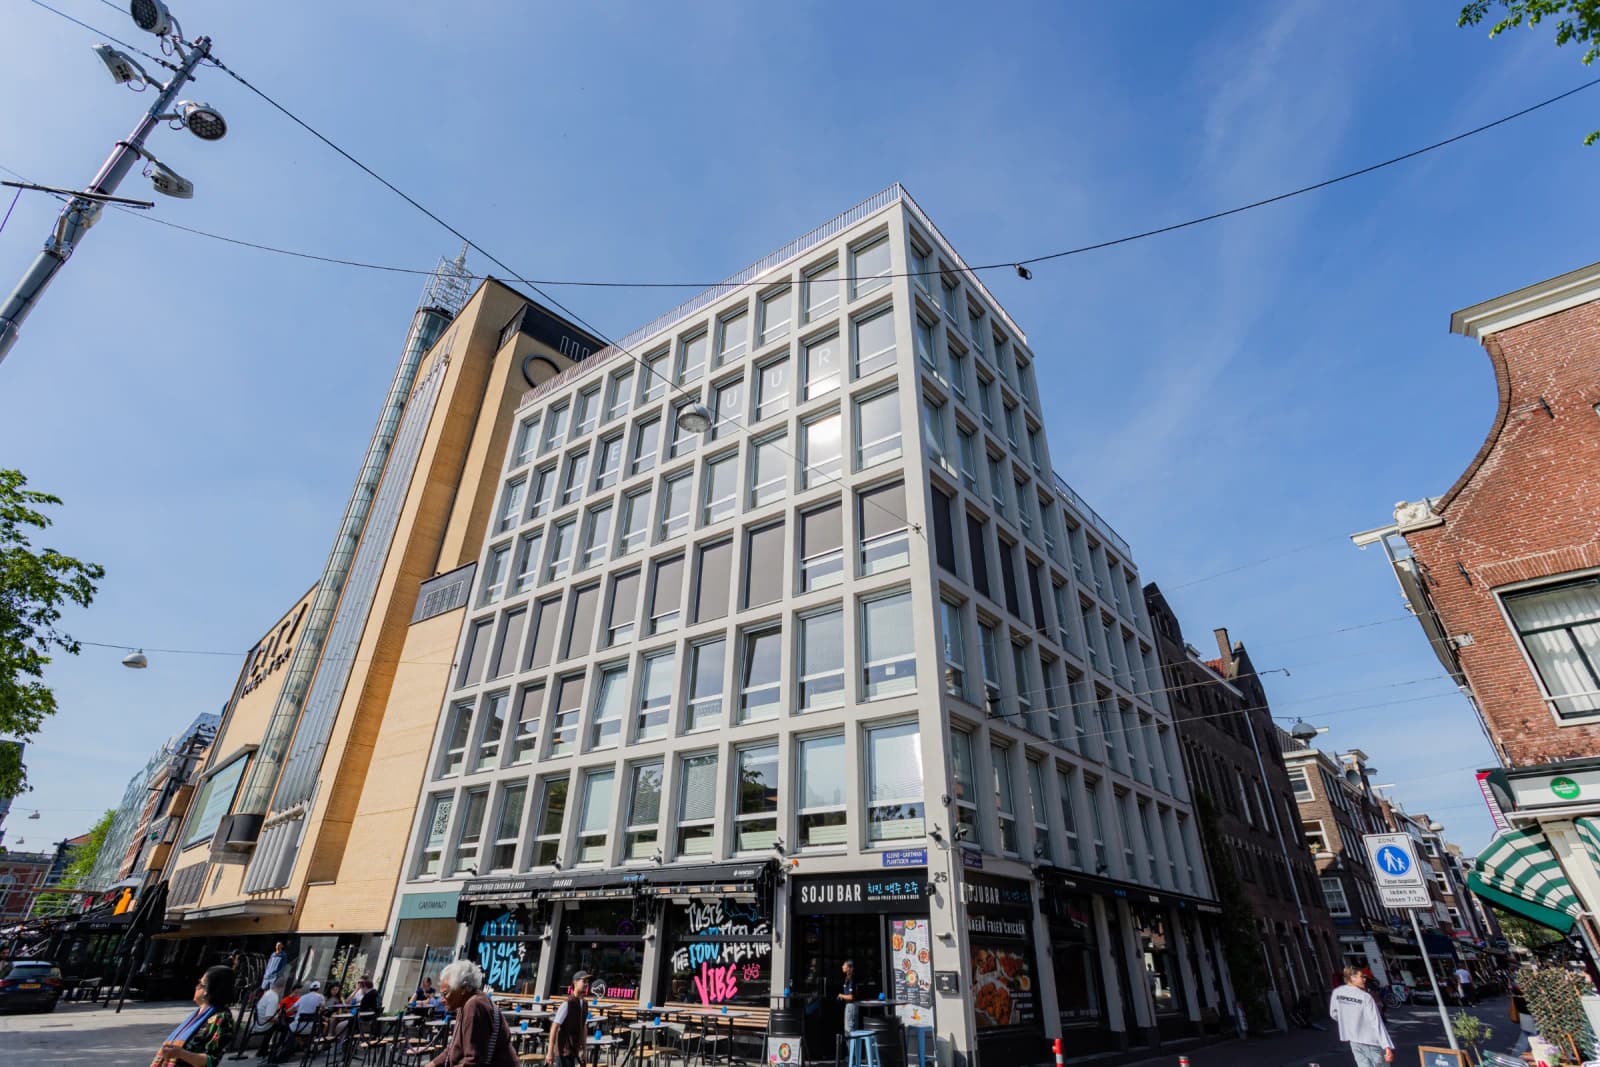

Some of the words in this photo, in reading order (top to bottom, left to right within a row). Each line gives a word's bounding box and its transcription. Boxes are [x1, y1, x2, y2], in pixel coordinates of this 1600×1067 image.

[250, 603, 309, 677] CITY
[1377, 836, 1397, 844] ZONE
[934, 872, 947, 882] 25
[801, 885, 834, 903] SOJU
[836, 884, 861, 902] BAR
[684, 901, 724, 933] TASTE
[488, 954, 521, 991] BAR
[671, 947, 689, 973] THE
[607, 987, 635, 998] EVERYDAY
[694, 962, 738, 1007] VIBE
